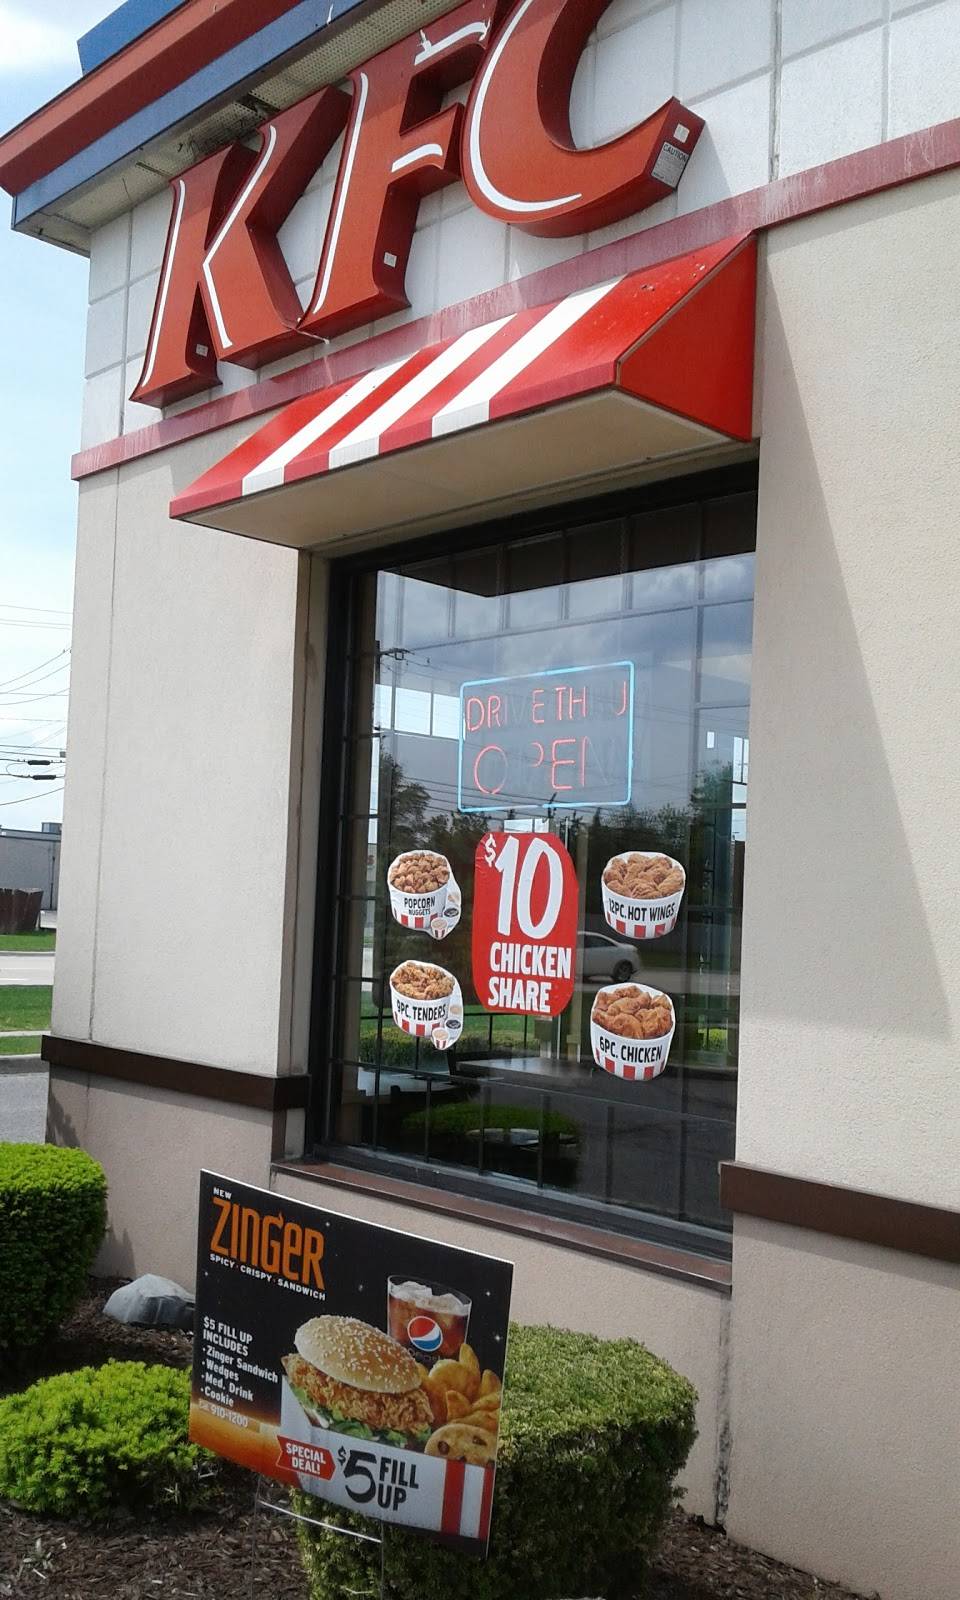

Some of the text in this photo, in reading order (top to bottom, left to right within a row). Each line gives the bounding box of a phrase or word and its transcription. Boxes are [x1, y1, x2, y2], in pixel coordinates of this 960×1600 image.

[130, 0, 704, 407] KFC
[555, 681, 627, 721] THU
[484, 834, 563, 939] $10
[404, 895, 436, 909] POPCORN
[408, 908, 431, 916] NUGGETS
[628, 907, 647, 922] HOT
[649, 902, 676, 922] WINGS
[490, 942, 572, 979] CHICKEN
[488, 976, 552, 1013] SHARE
[413, 1004, 446, 1021] TENDERS
[620, 1045, 663, 1063] CHICKEN
[213, 1187, 232, 1199] NEW
[210, 1253, 326, 1301] SPICY CRISPY SANDWICH
[203, 1316, 253, 1344] $5 FILL UP
[203, 1329, 249, 1356] INCLUDES
[206, 1345, 279, 1383] Zinger Sandwich
[206, 1358, 239, 1381] Wedges
[204, 1386, 234, 1407] Cookie
[205, 1372, 254, 1401] Med. Drink
[285, 1442, 326, 1464] SPECIAL
[291, 1458, 321, 1475] DEAL!
[337, 1445, 419, 1503] $5 FILL
[377, 1483, 407, 1511] UP
